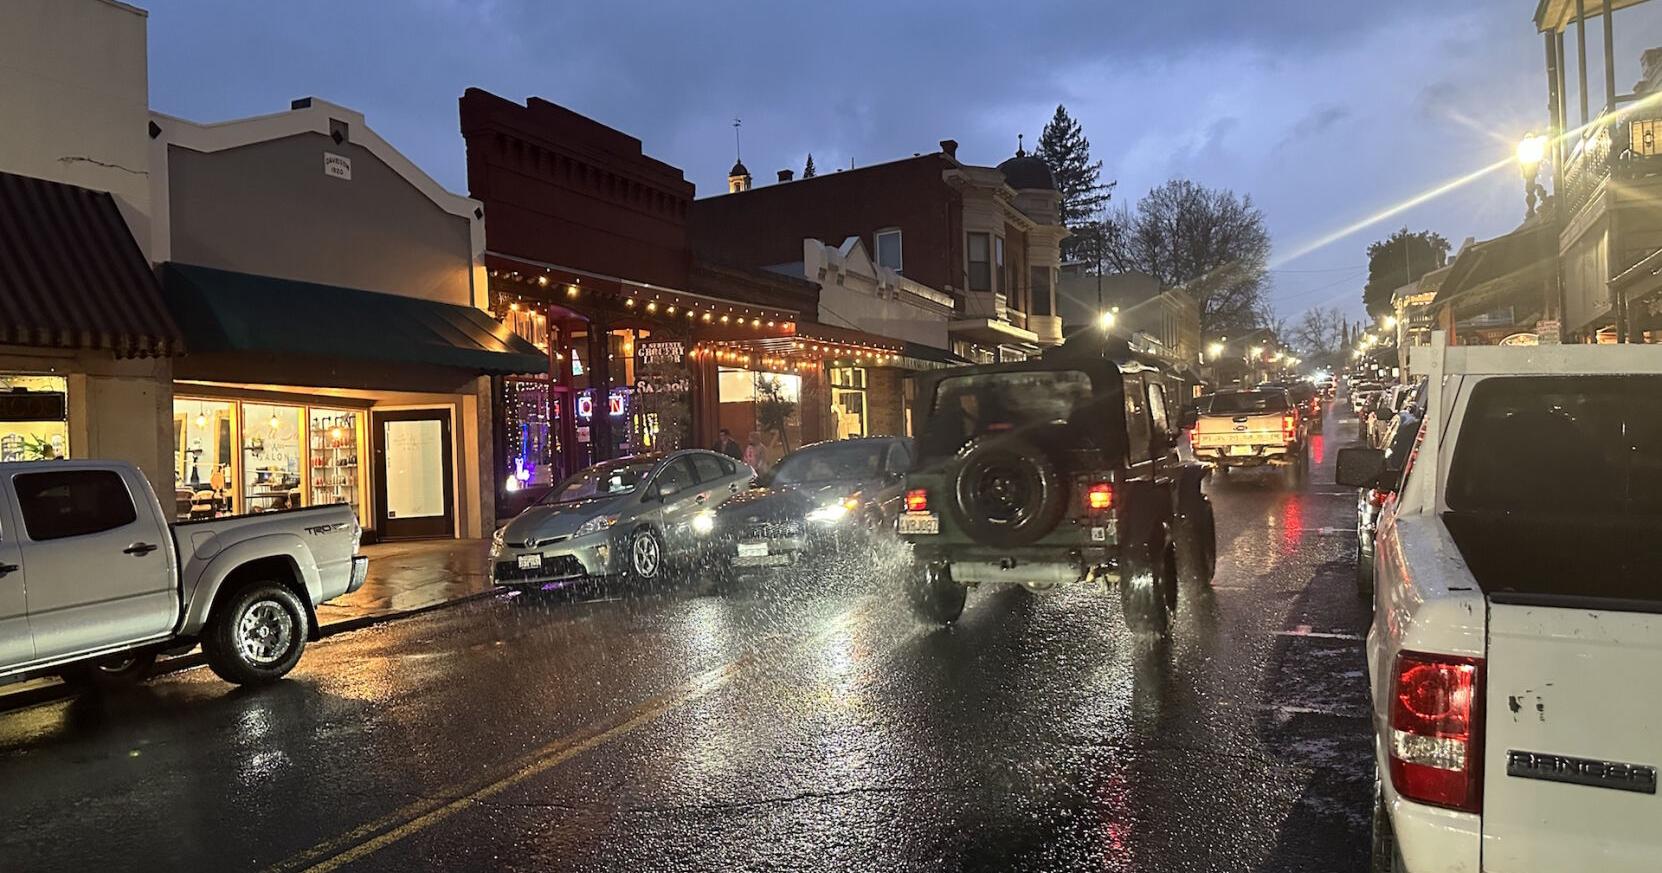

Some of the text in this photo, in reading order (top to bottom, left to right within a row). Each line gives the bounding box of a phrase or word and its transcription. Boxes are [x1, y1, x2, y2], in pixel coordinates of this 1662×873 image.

[638, 346, 685, 357] GROCERY
[304, 524, 332, 536] TRD
[1508, 751, 1656, 793] RANGER
